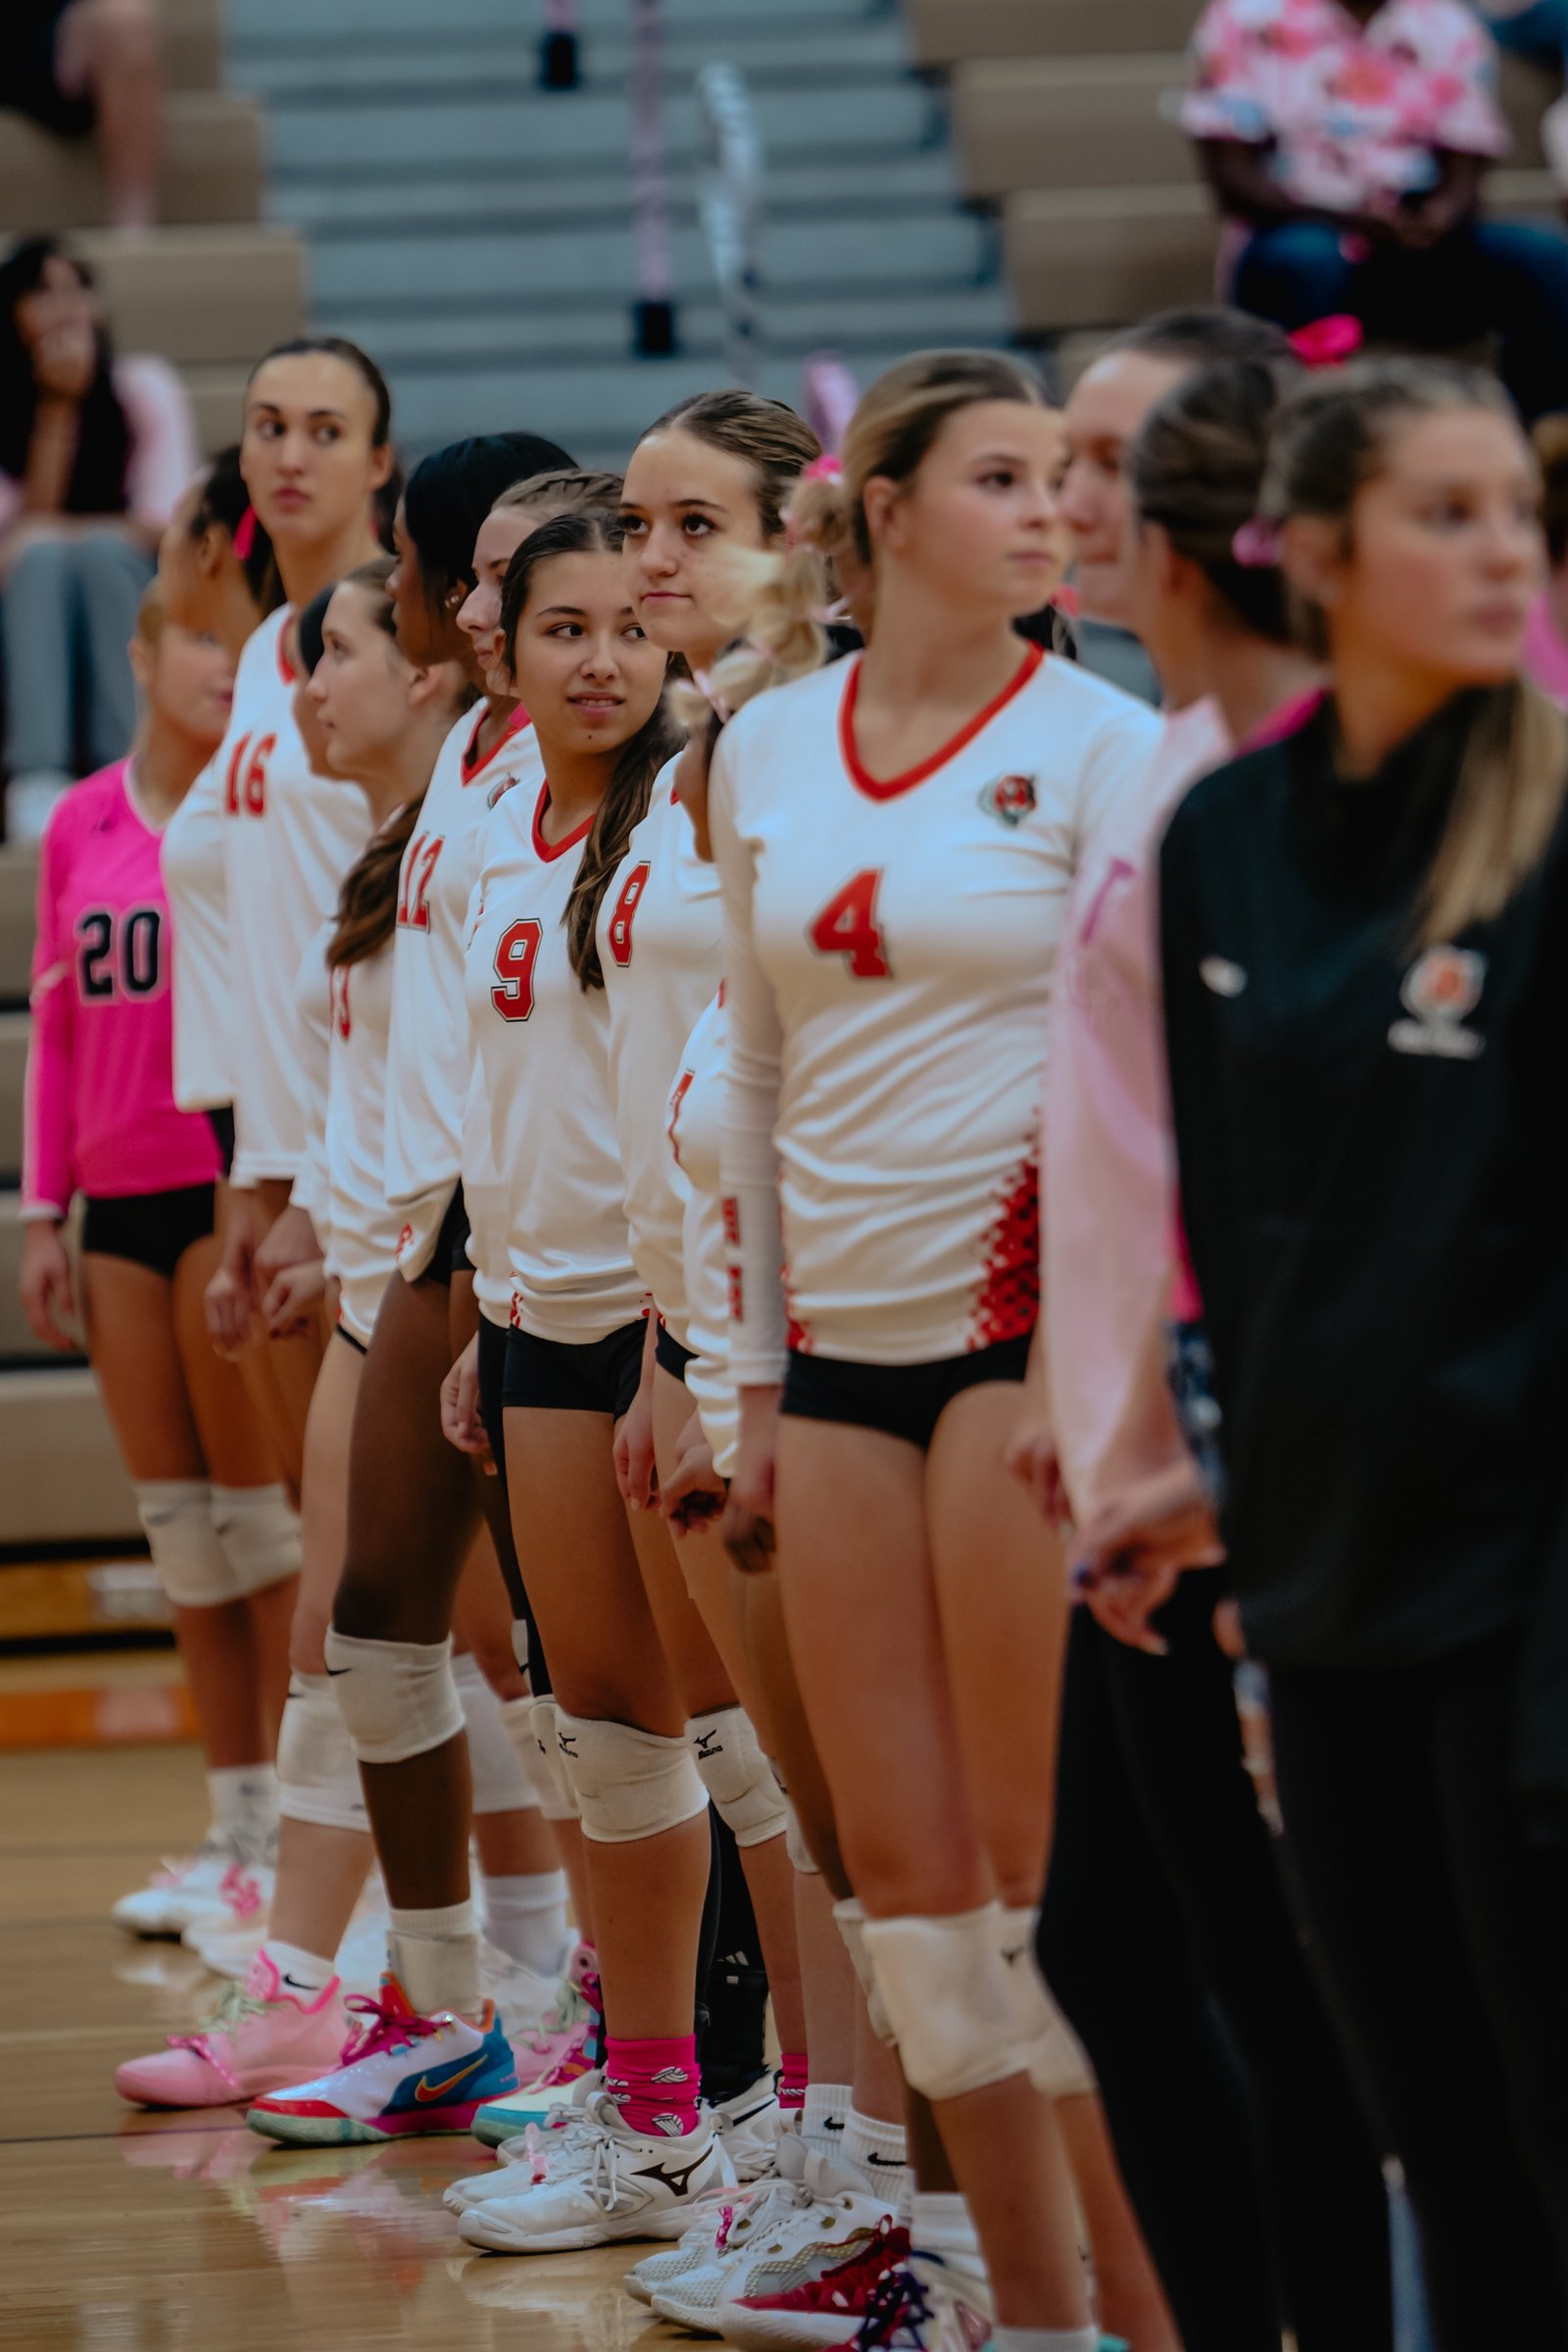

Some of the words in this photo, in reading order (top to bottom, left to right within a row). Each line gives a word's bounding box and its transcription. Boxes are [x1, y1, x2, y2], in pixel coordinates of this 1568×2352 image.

[224, 731, 277, 818] 16
[77, 907, 164, 1001] 20
[608, 859, 651, 968] 8
[806, 867, 895, 981] 4
[491, 917, 544, 1022] 9
